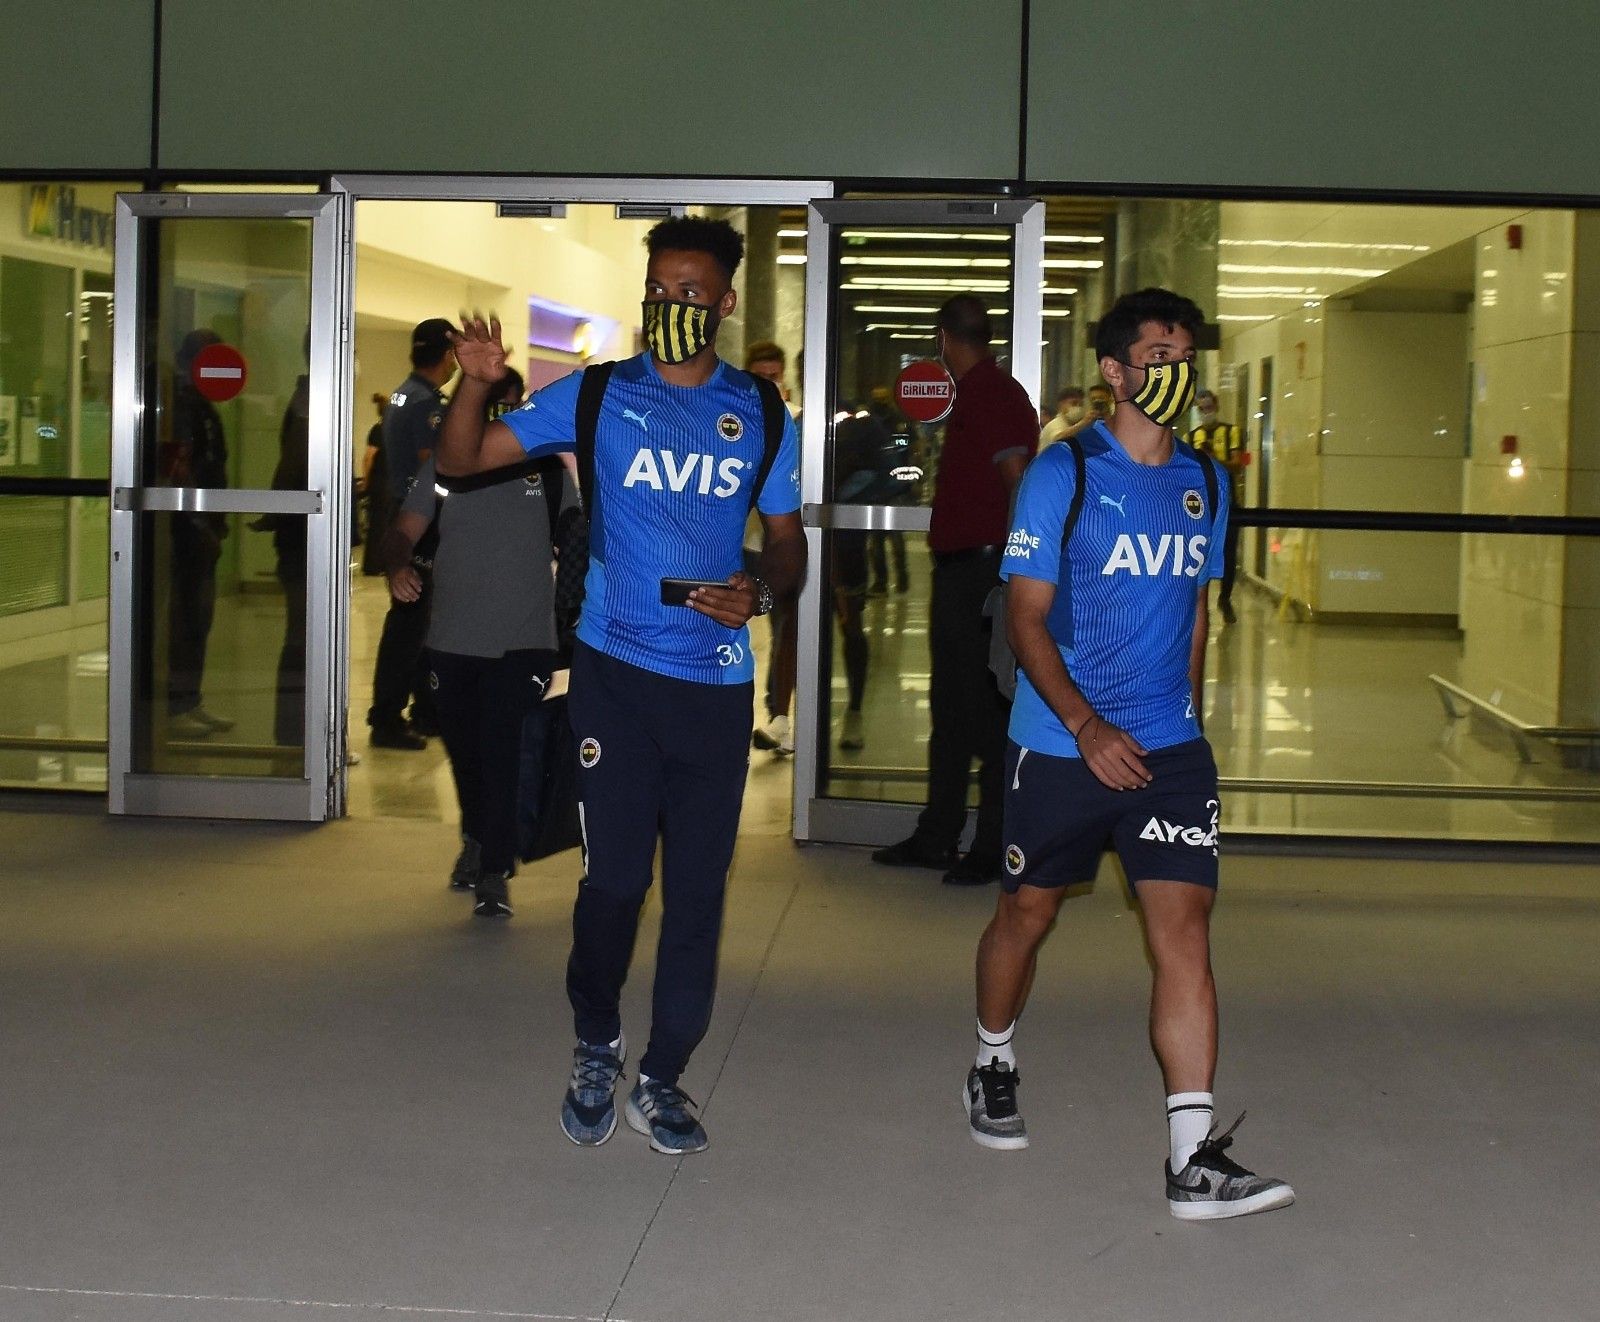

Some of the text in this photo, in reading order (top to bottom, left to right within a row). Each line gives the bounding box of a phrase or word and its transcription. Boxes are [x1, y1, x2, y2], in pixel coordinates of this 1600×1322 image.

[902, 383, 948, 396] GİRİLMEZ
[623, 448, 745, 498] AVIS
[1101, 534, 1207, 577] AVIS
